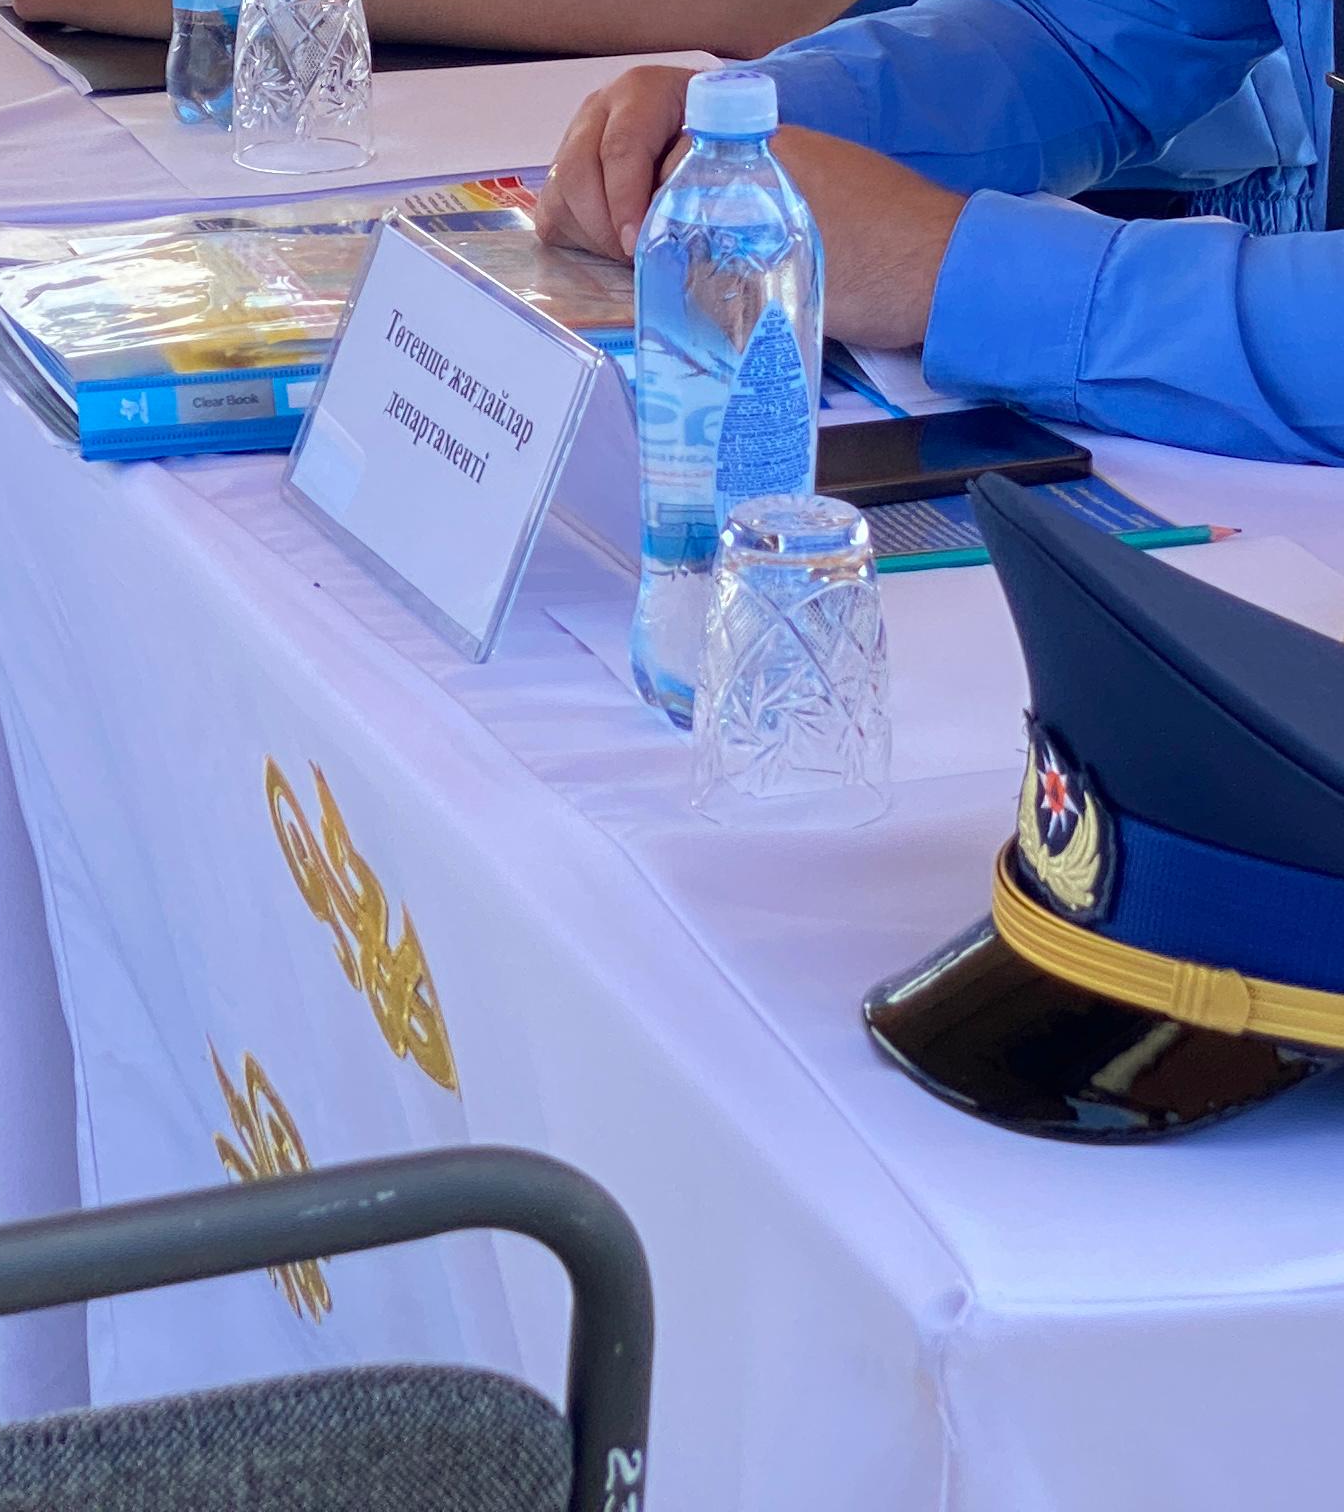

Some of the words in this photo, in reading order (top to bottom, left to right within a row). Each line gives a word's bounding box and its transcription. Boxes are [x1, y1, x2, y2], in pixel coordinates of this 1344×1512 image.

[192, 396, 225, 409] Clear
[226, 393, 260, 407] Book
[385, 308, 450, 382] Төтенше
[447, 364, 535, 453] жағдайлар
[383, 390, 492, 485] департаменті
